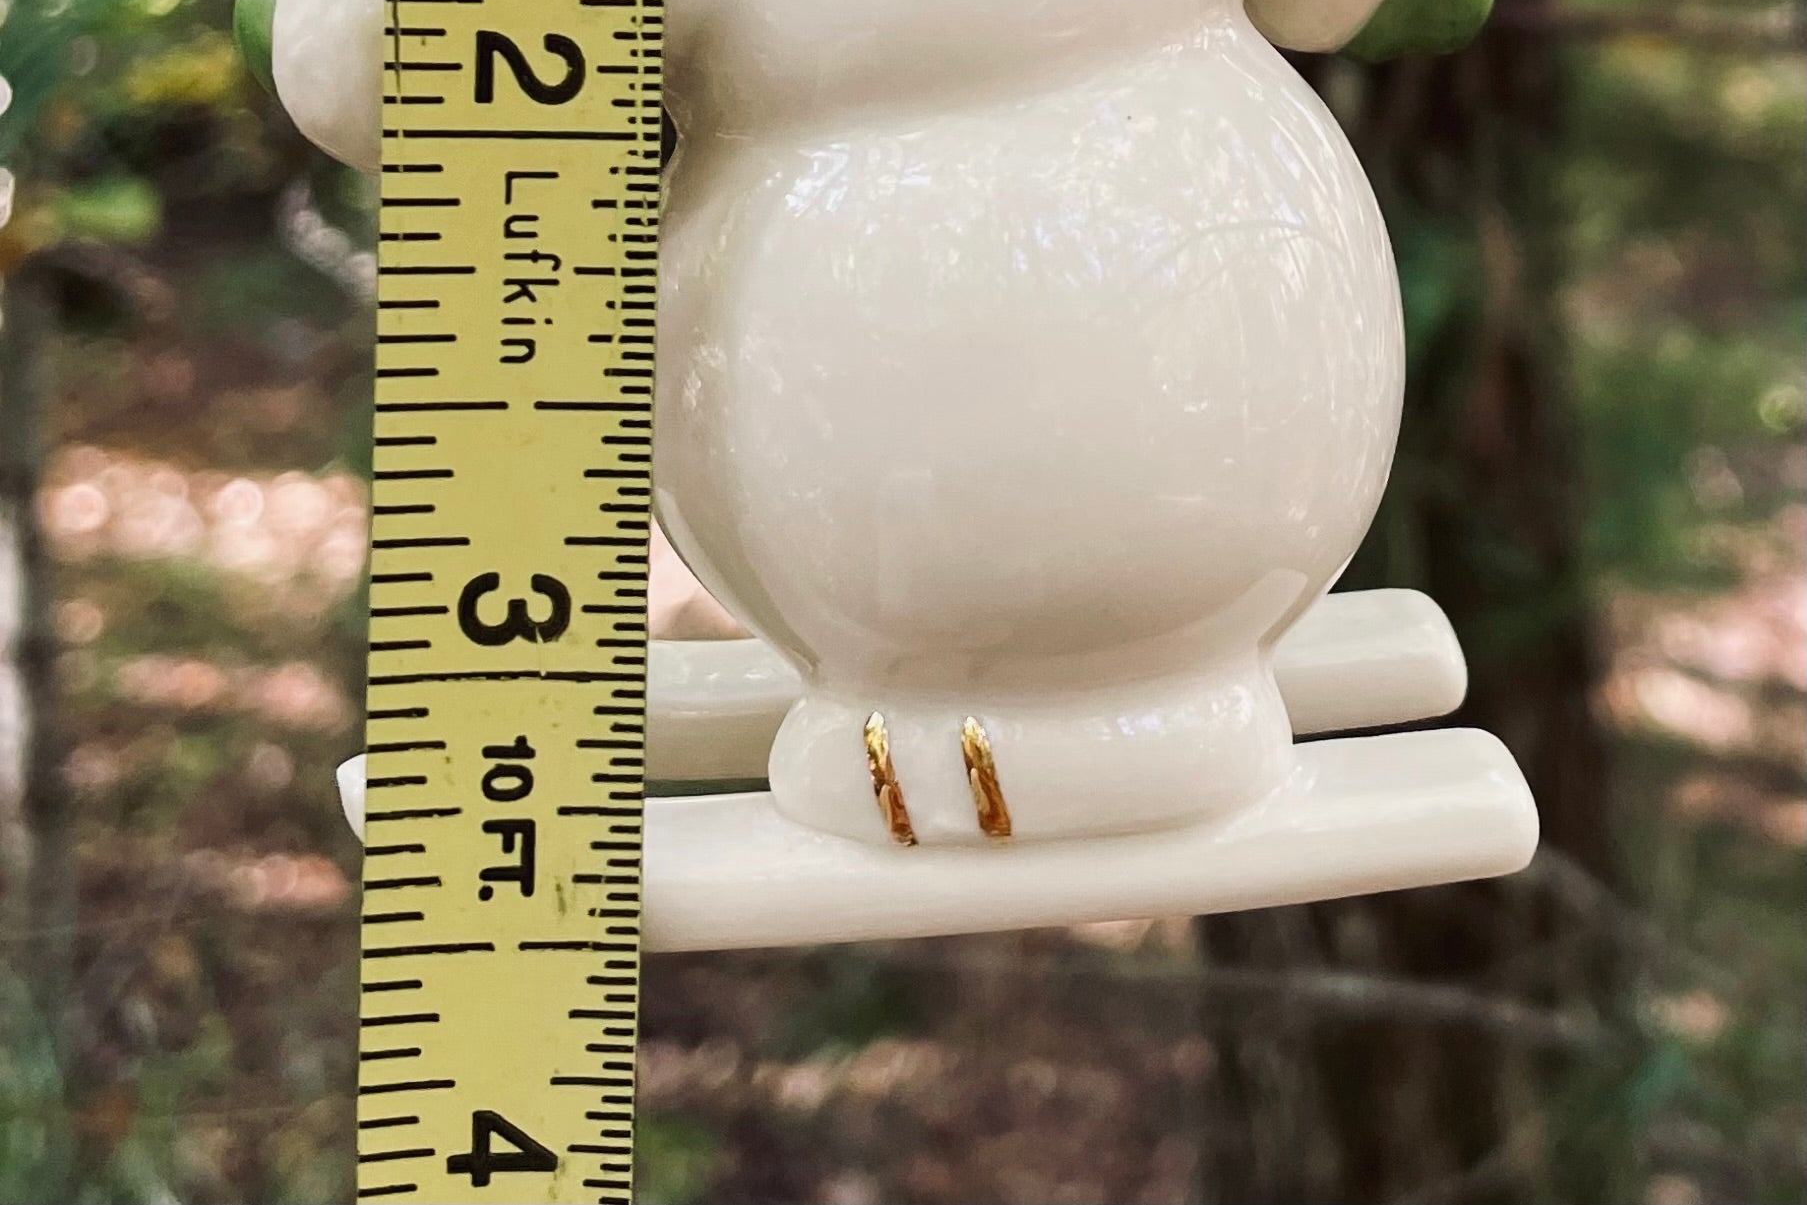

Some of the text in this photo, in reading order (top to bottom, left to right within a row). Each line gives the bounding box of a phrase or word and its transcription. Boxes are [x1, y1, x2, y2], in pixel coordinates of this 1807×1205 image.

[474, 30, 586, 106] 2
[499, 170, 562, 364] Lufkin
[457, 571, 572, 647] 3
[478, 735, 536, 902] 10 FT.
[446, 1110, 559, 1188] 4
